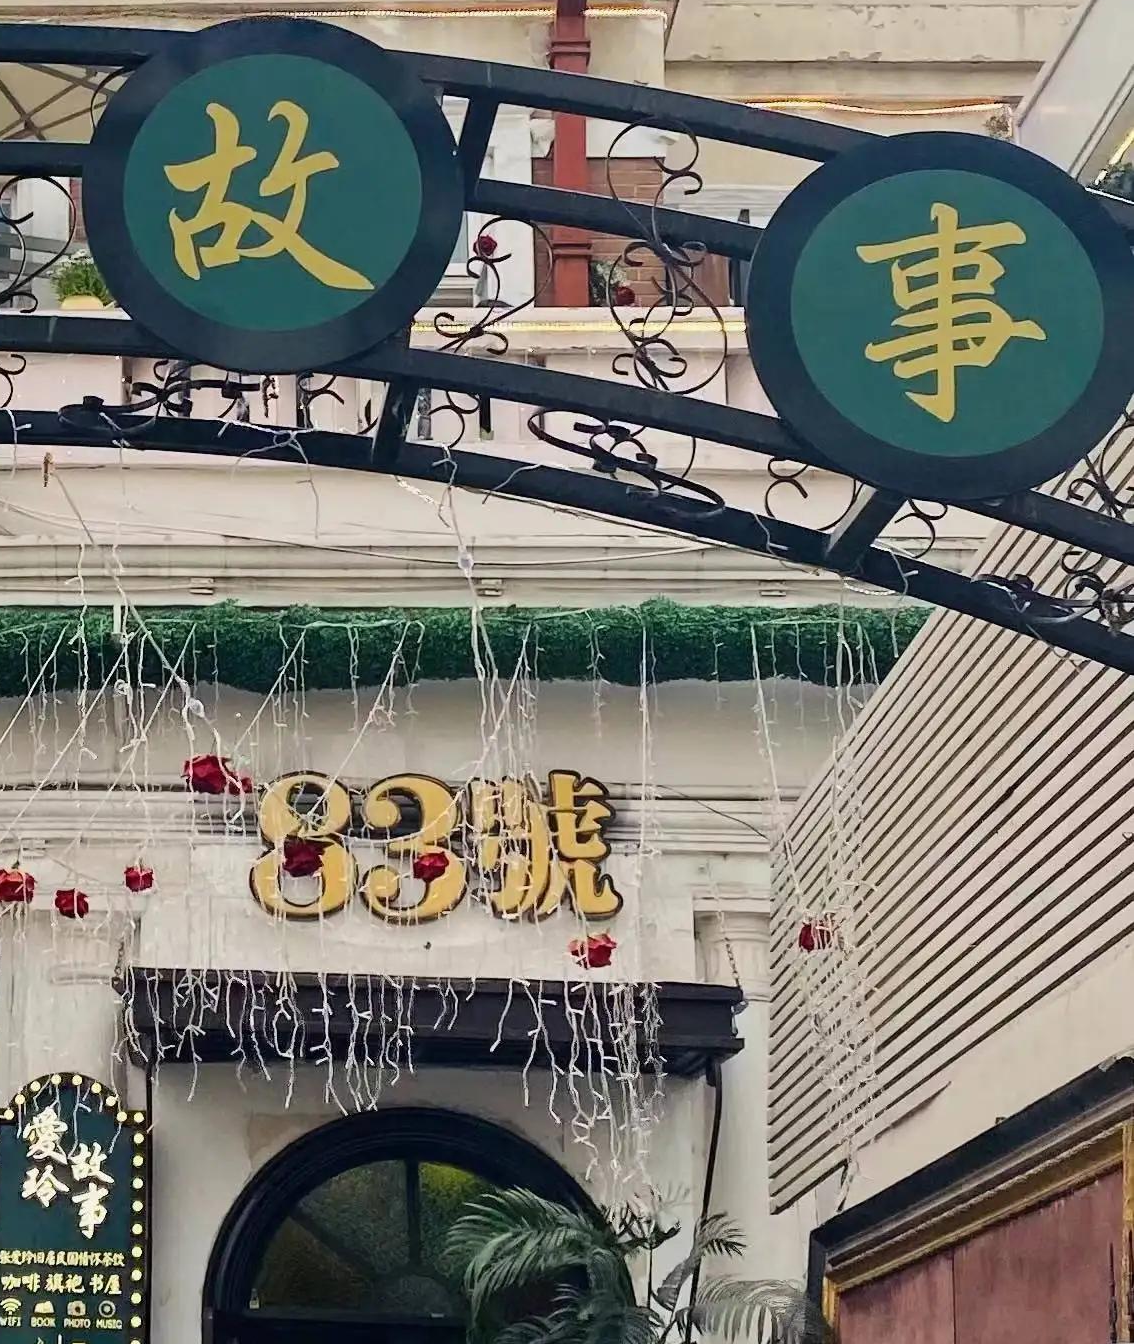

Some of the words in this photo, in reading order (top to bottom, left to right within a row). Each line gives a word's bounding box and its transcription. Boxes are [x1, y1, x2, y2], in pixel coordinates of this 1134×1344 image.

[70, 1142, 115, 1239] 故事
[0, 1272, 41, 1293] 咖啡
[44, 1272, 85, 1294] 旗袍
[89, 1273, 122, 1295] 书屋
[0, 1316, 21, 1327] WIFI
[30, 1317, 56, 1328] BOOK
[63, 1318, 91, 1329] PHOTO
